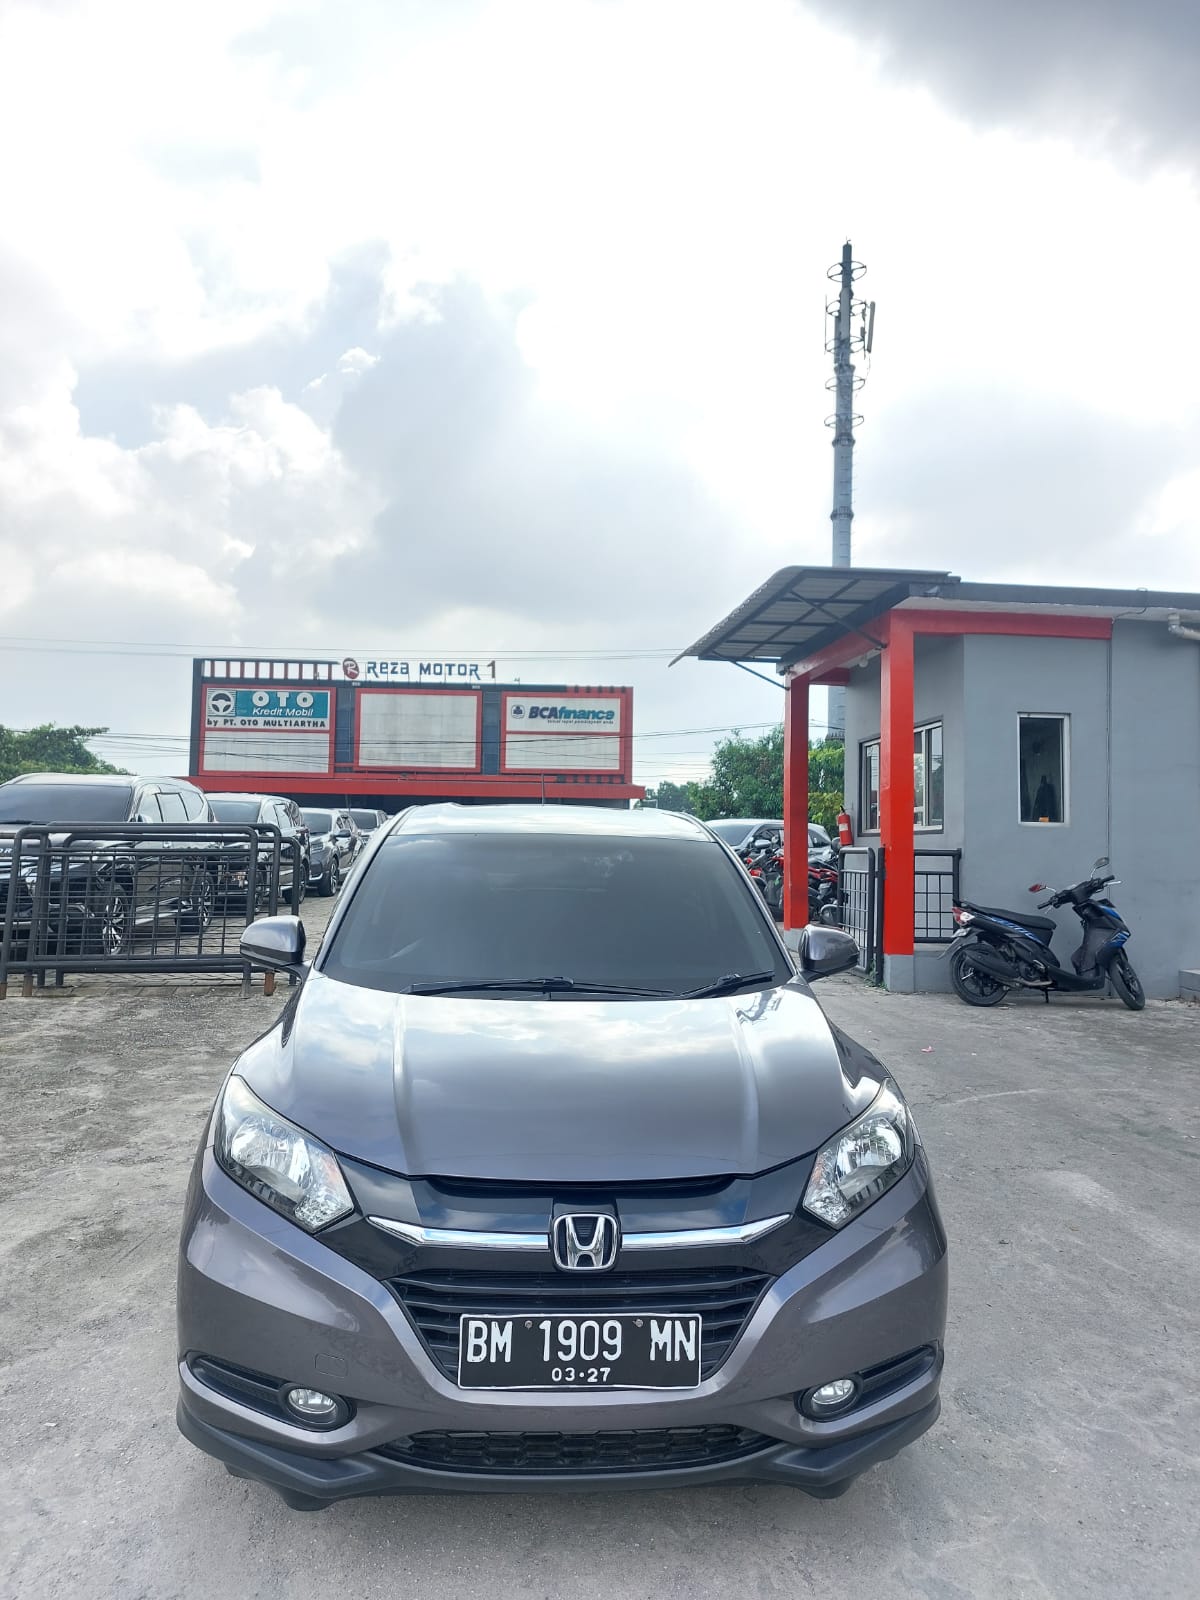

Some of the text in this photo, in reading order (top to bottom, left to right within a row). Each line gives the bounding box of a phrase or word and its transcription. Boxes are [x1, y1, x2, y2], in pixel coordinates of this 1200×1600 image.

[419, 662, 481, 680] MOTOR
[487, 660, 496, 679] 1
[252, 691, 314, 708] OTO
[252, 707, 314, 717] Kredit Mobil
[207, 718, 218, 727] by
[263, 719, 326, 728] MULTIARTHA
[466, 1319, 696, 1363] BM 1909 MN
